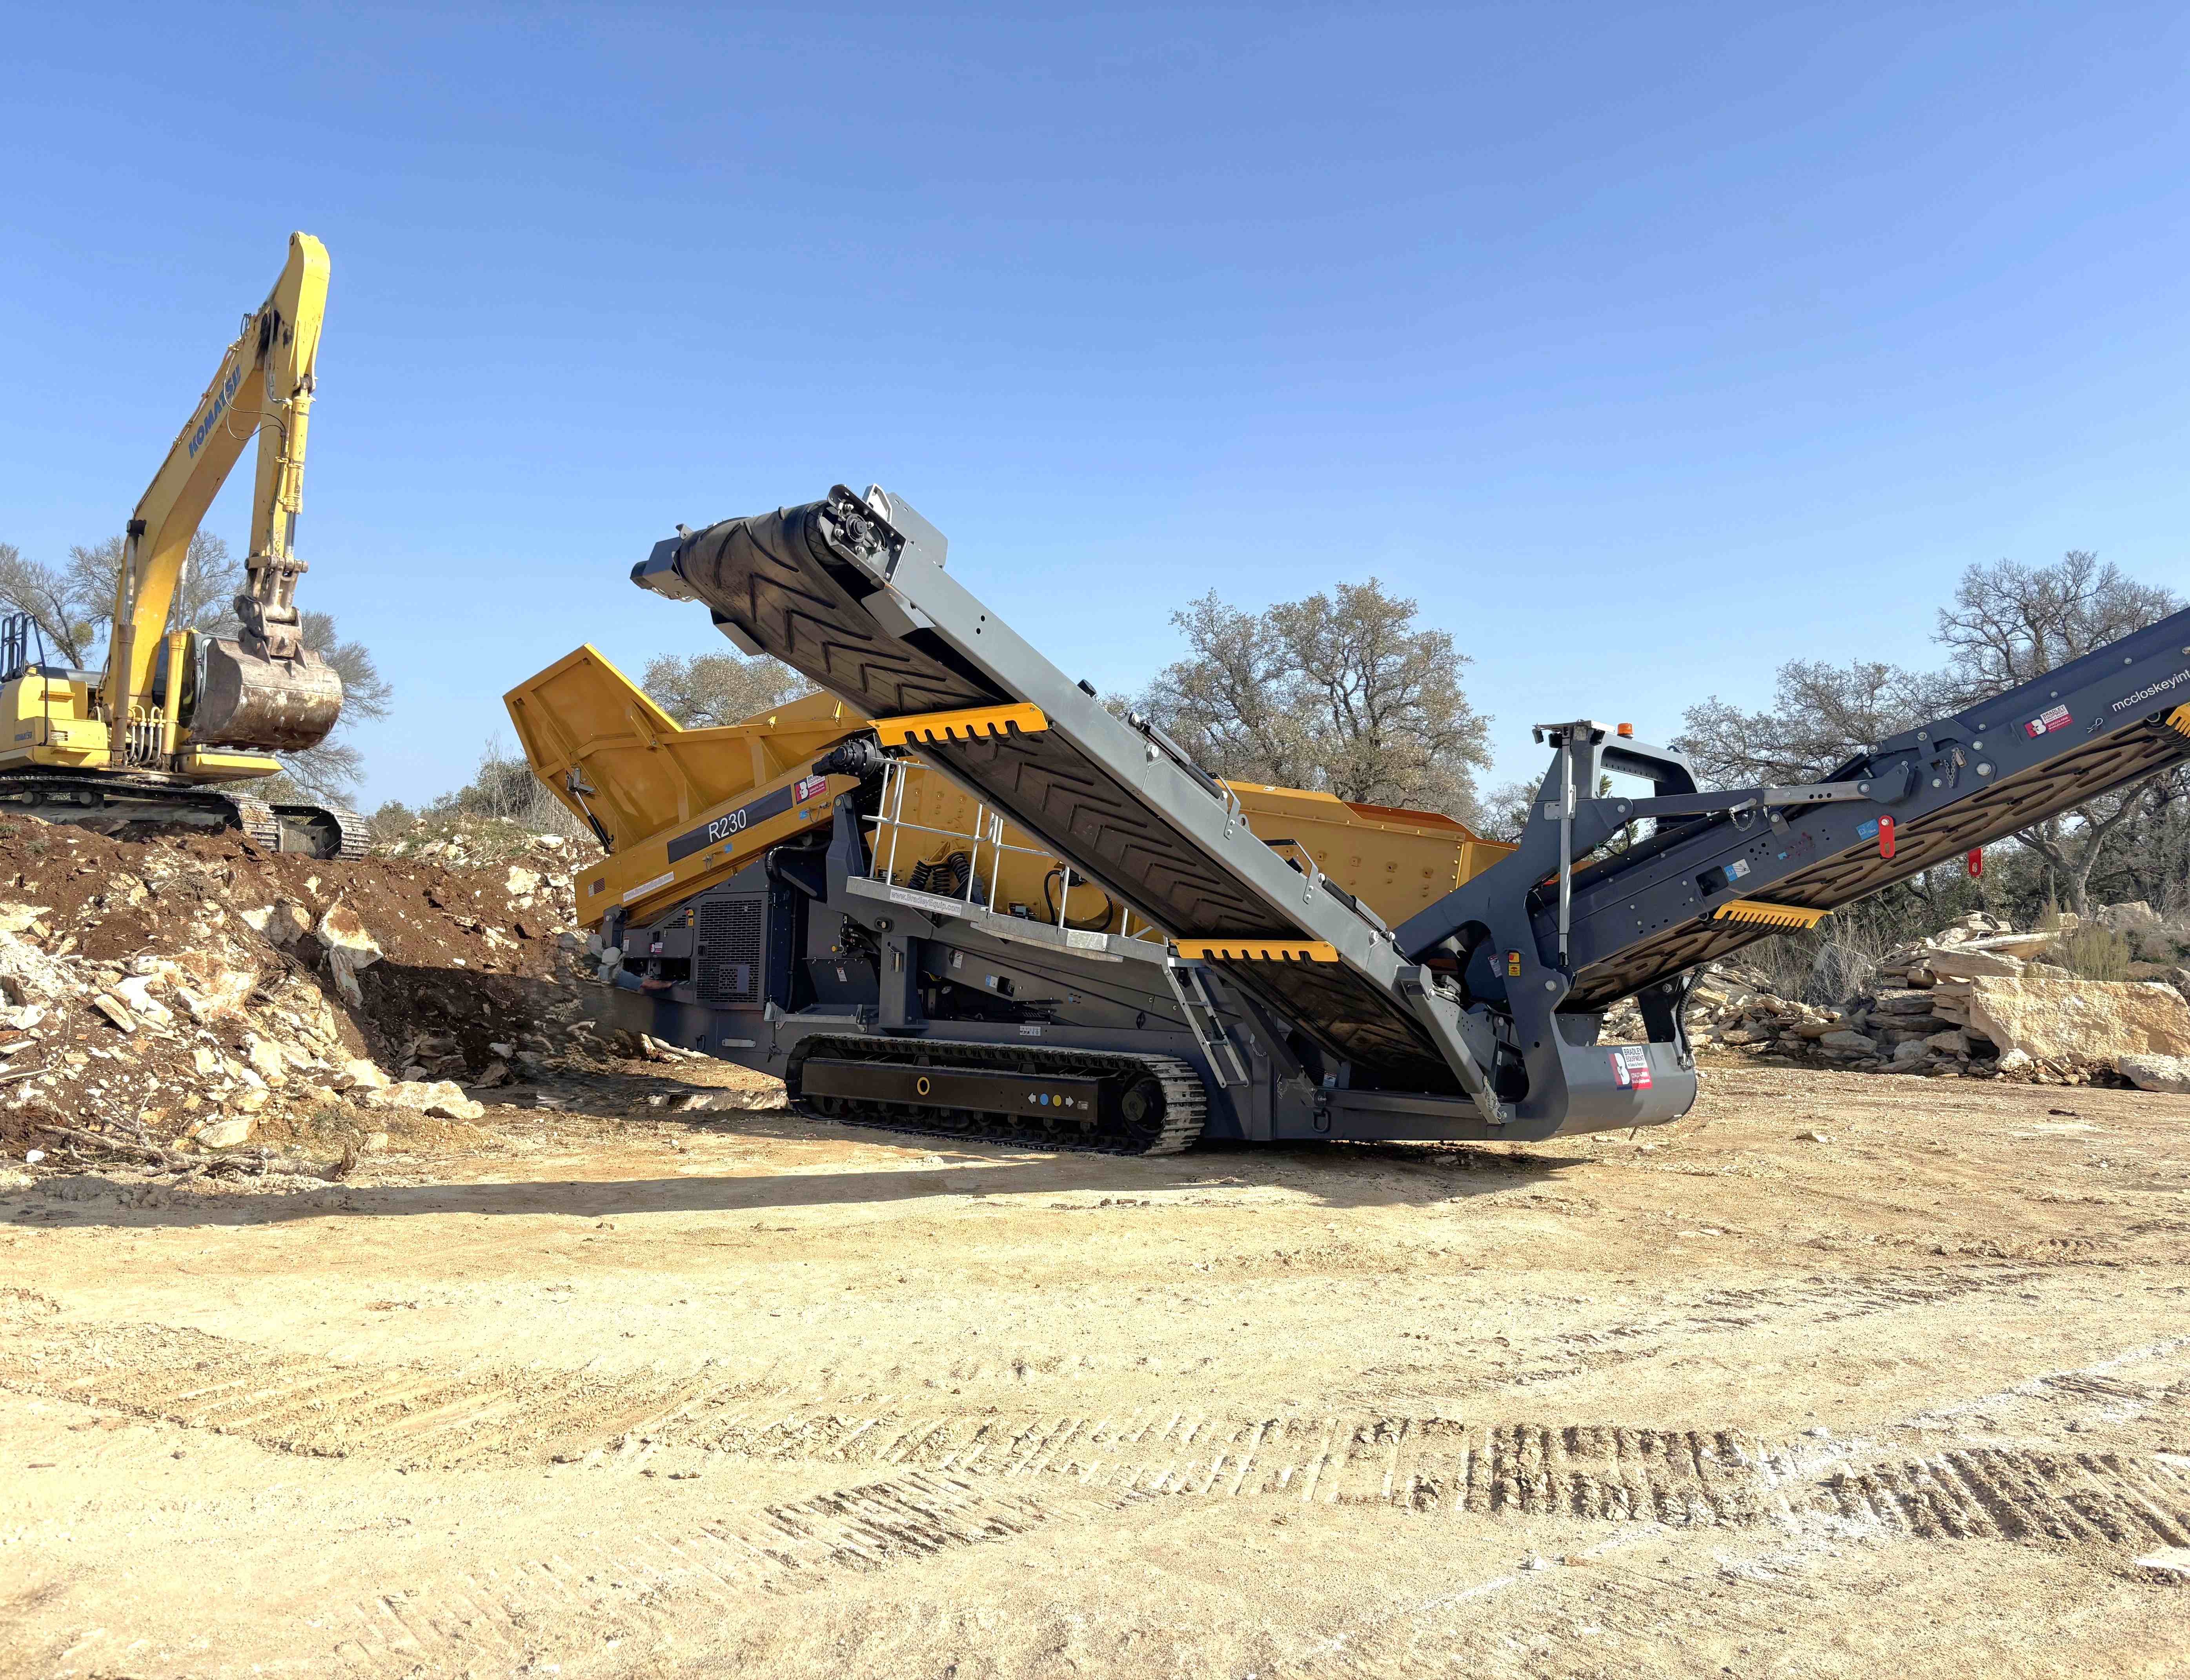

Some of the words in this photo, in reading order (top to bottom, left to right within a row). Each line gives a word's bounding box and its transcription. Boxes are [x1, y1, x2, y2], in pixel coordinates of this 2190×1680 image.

[188, 364, 241, 458] KOMATSU
[2112, 669, 2190, 712] mccloskeyint
[709, 809, 746, 842] R230
[891, 892, 961, 913] www.BradleyEquip.com
